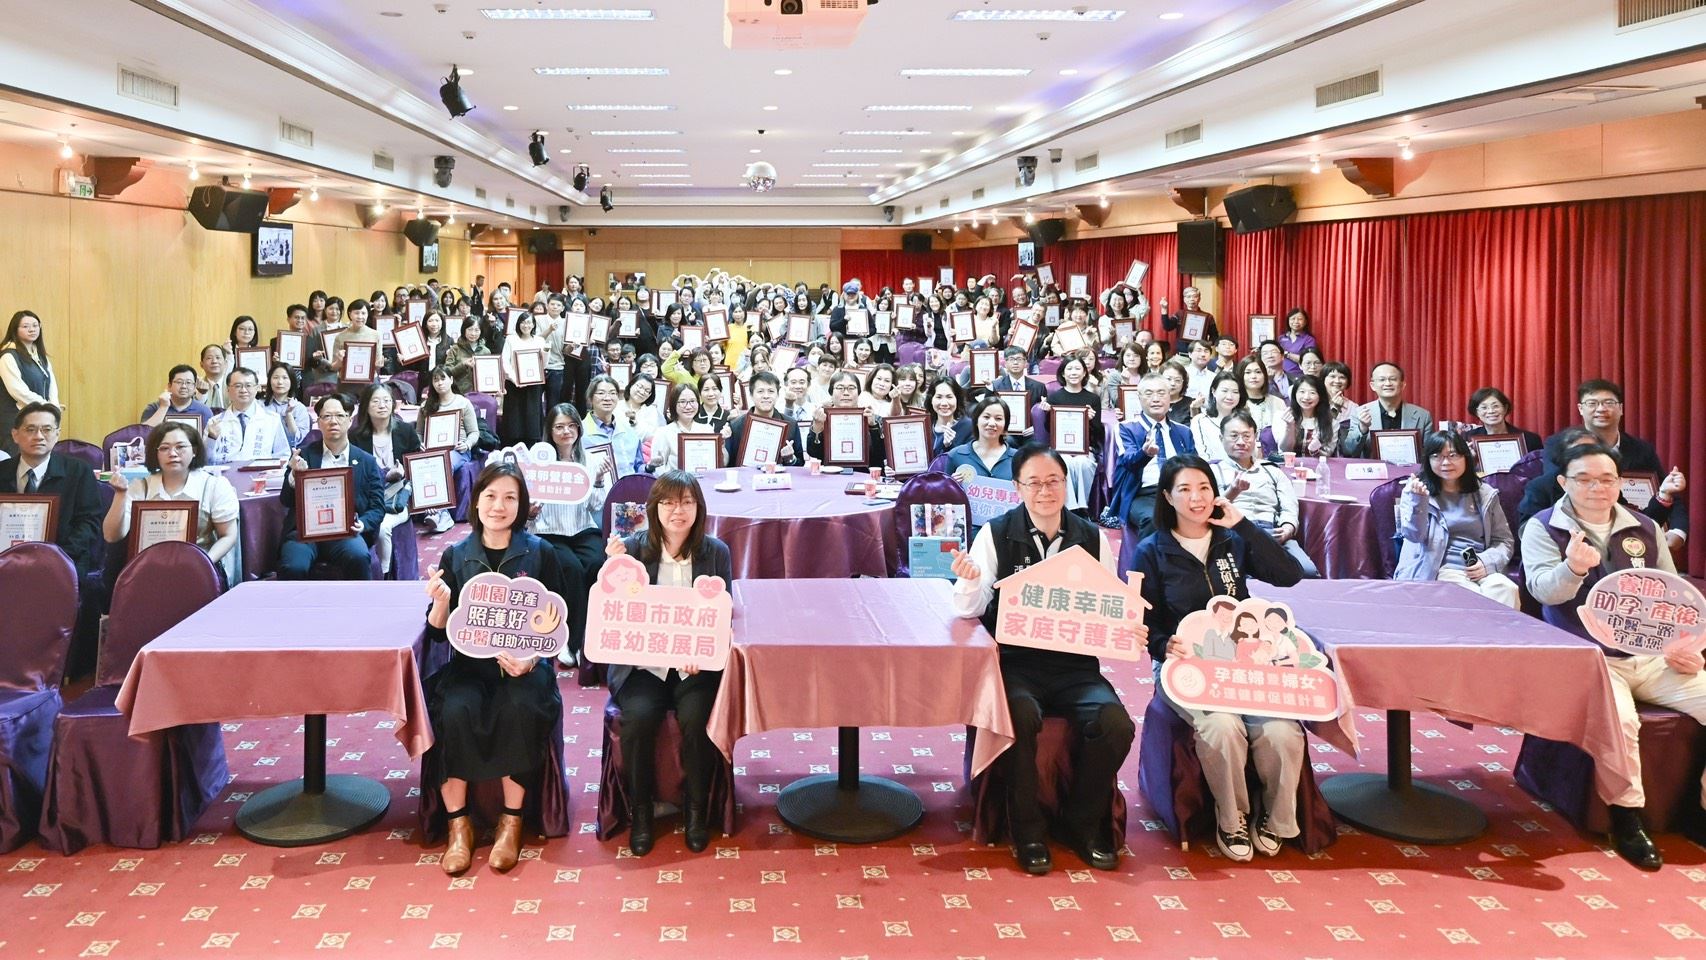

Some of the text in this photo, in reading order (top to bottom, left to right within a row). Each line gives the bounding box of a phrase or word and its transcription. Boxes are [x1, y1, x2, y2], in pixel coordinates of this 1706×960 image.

[602, 600, 718, 628] 桃園市政府
[1020, 583, 1125, 620] 健康幸福
[467, 605, 528, 630] 照護好
[1607, 614, 1674, 639] 中醫一路
[599, 629, 716, 657] 婦幼發展局
[1003, 612, 1136, 652] 家庭守護者
[1613, 629, 1663, 650] 守護您
